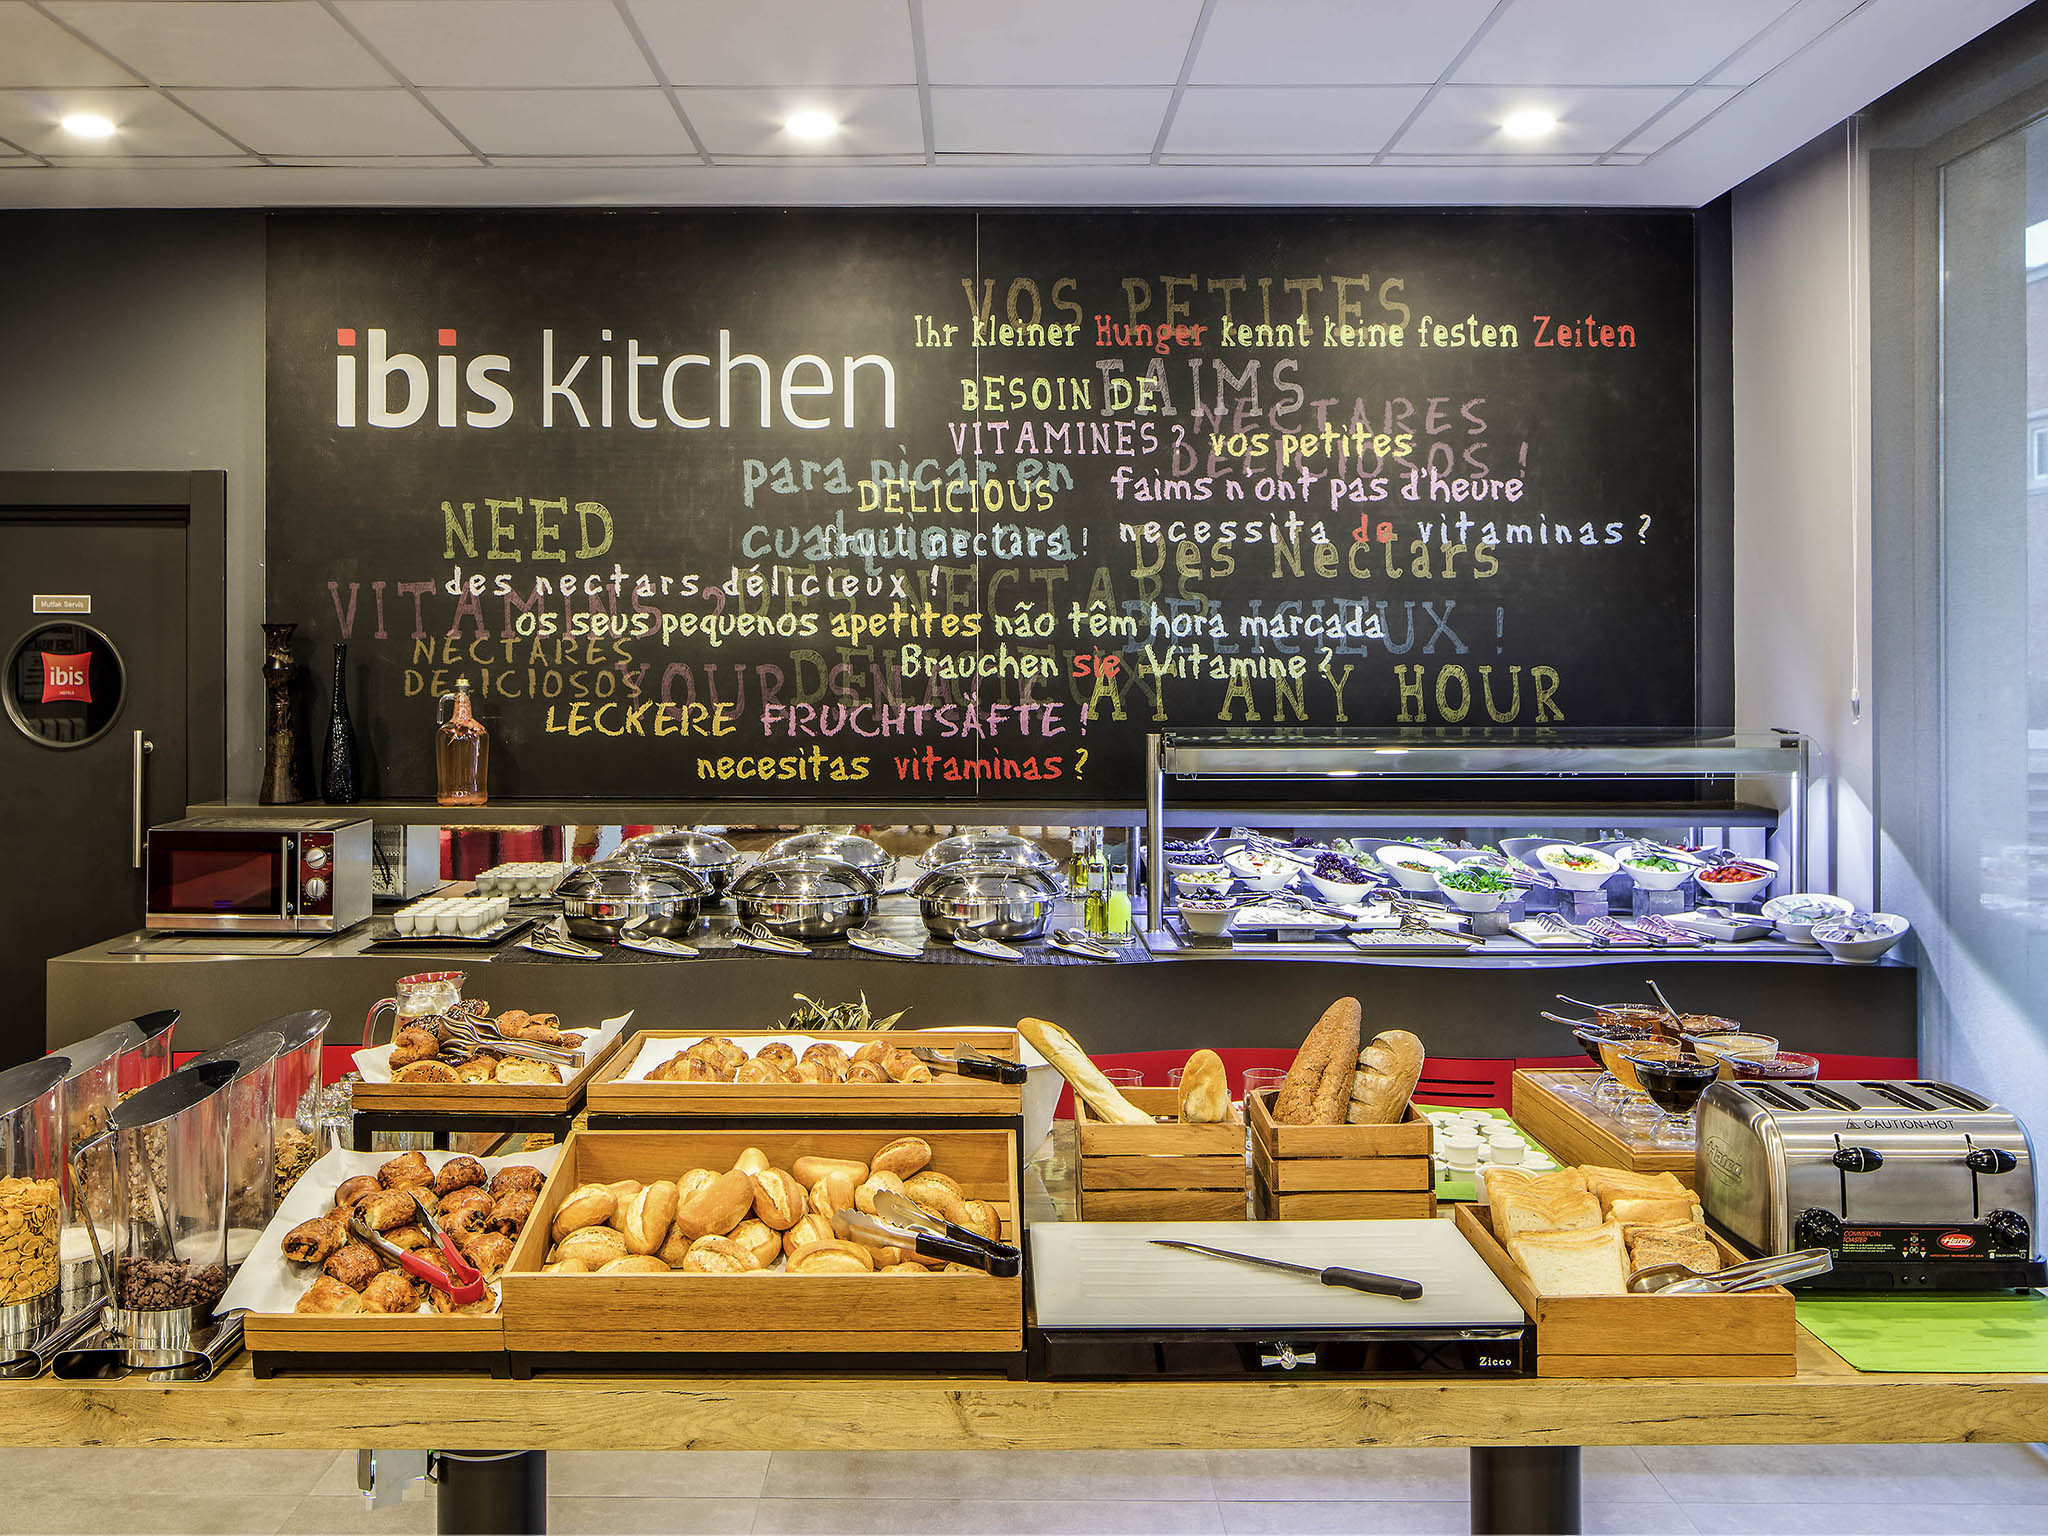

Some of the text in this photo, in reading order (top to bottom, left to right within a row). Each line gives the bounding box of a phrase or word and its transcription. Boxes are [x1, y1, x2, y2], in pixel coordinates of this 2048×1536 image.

[961, 273, 1412, 338] VOS PETITES
[914, 314, 1637, 355] Ihr kleiner Hunger kennt keine festen Zeiten
[336, 328, 896, 429] ibis kitchen
[961, 375, 1157, 412] BESOIN DE
[1096, 357, 1305, 418] FAIMS
[1194, 397, 1488, 436] NECTARES
[948, 420, 1158, 456] VITAMINES
[1209, 422, 1414, 468] vos petites
[743, 456, 853, 509] para
[1015, 458, 1075, 493] en
[857, 477, 1056, 514] DELICIOUS
[1110, 465, 1213, 502] faims
[1330, 475, 1389, 512] pas
[1401, 464, 1526, 502] d'heure
[441, 496, 615, 563] NEED
[822, 523, 909, 559] fruit
[929, 521, 1065, 559] nectars
[1120, 511, 1652, 546] necessita de vitaminas ?
[1130, 524, 1500, 580] Des Nectars
[445, 564, 513, 597] des
[535, 563, 701, 599] nectars
[722, 563, 908, 599] délicieux
[328, 579, 663, 640] VITAMINS
[515, 601, 1386, 648] os seus pequenos apetites não têm hora marcada
[413, 636, 634, 667] NECTARES
[901, 642, 1060, 680] Brauchen
[1073, 646, 1121, 679] sie
[1145, 643, 1307, 680] Vitamine
[50, 666, 84, 687] ibis
[1088, 662, 1566, 724] AT ANY HOUR
[545, 700, 738, 737] LECKERE
[761, 692, 1067, 739] FRUCHTSÄFTE
[697, 746, 1090, 781] necesitas vitaminas ?
[1863, 1119, 1955, 1130] CAUTION-HOT
[1479, 1356, 1512, 1366] Zicco
